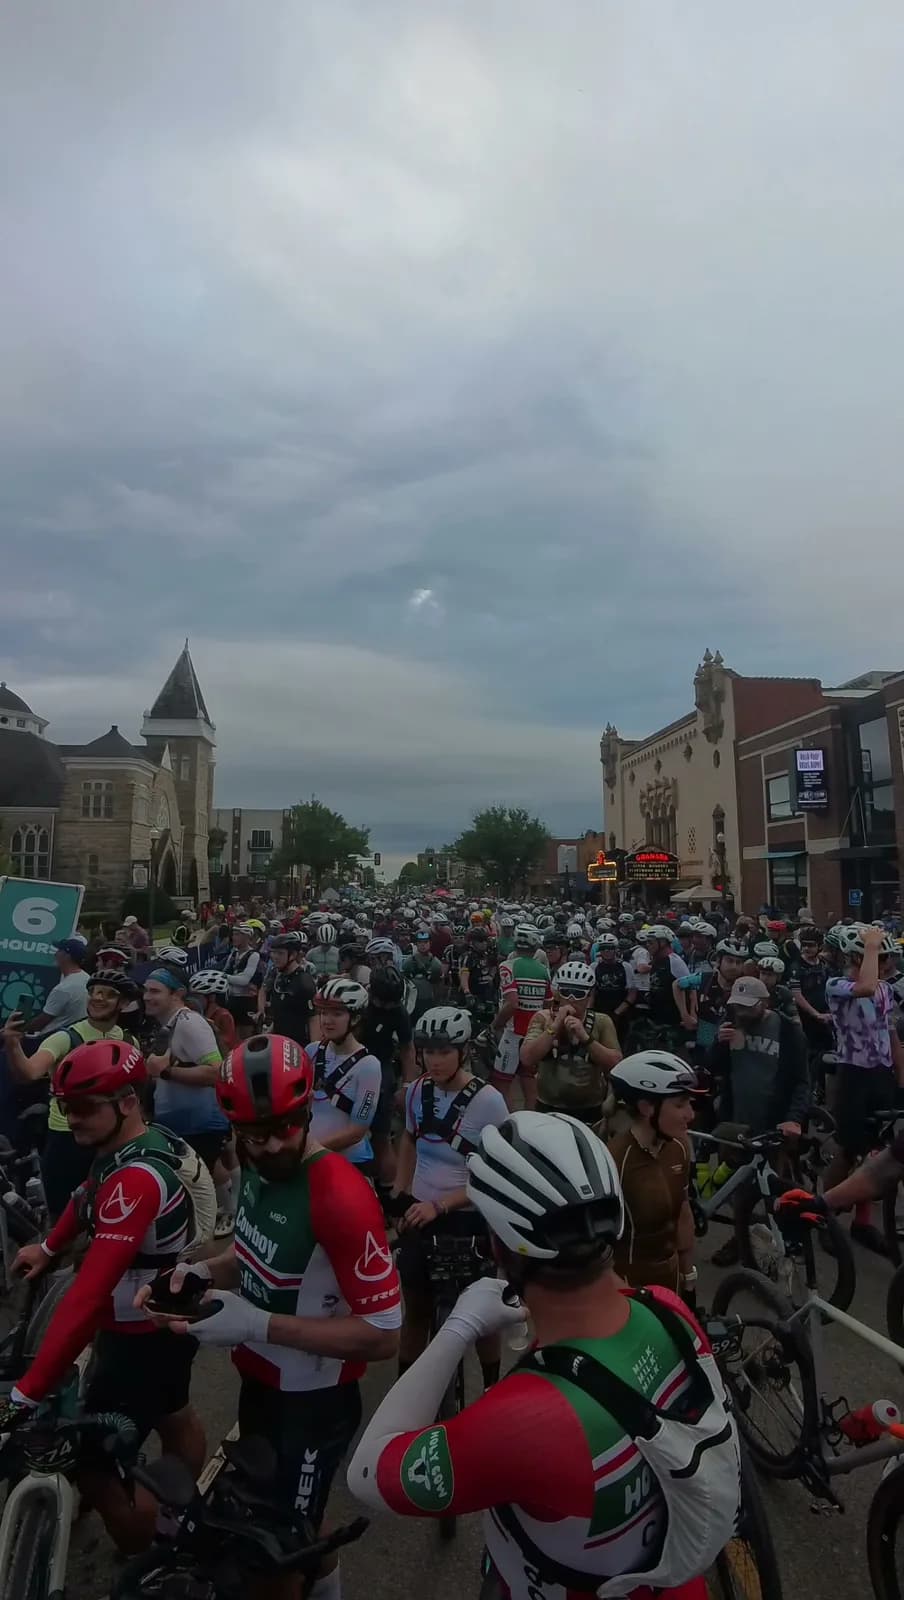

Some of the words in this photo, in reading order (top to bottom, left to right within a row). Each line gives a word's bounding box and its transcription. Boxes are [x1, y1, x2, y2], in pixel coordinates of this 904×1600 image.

[12, 896, 60, 936] 6
[0, 938, 59, 955] HOURS
[95, 1233, 136, 1243] TREK
[236, 1206, 279, 1265] Cowboy
[428, 1430, 441, 1462] HOLY
[294, 1447, 320, 1517] REK
[431, 1465, 448, 1498] COW
[624, 1464, 651, 1515] HO
